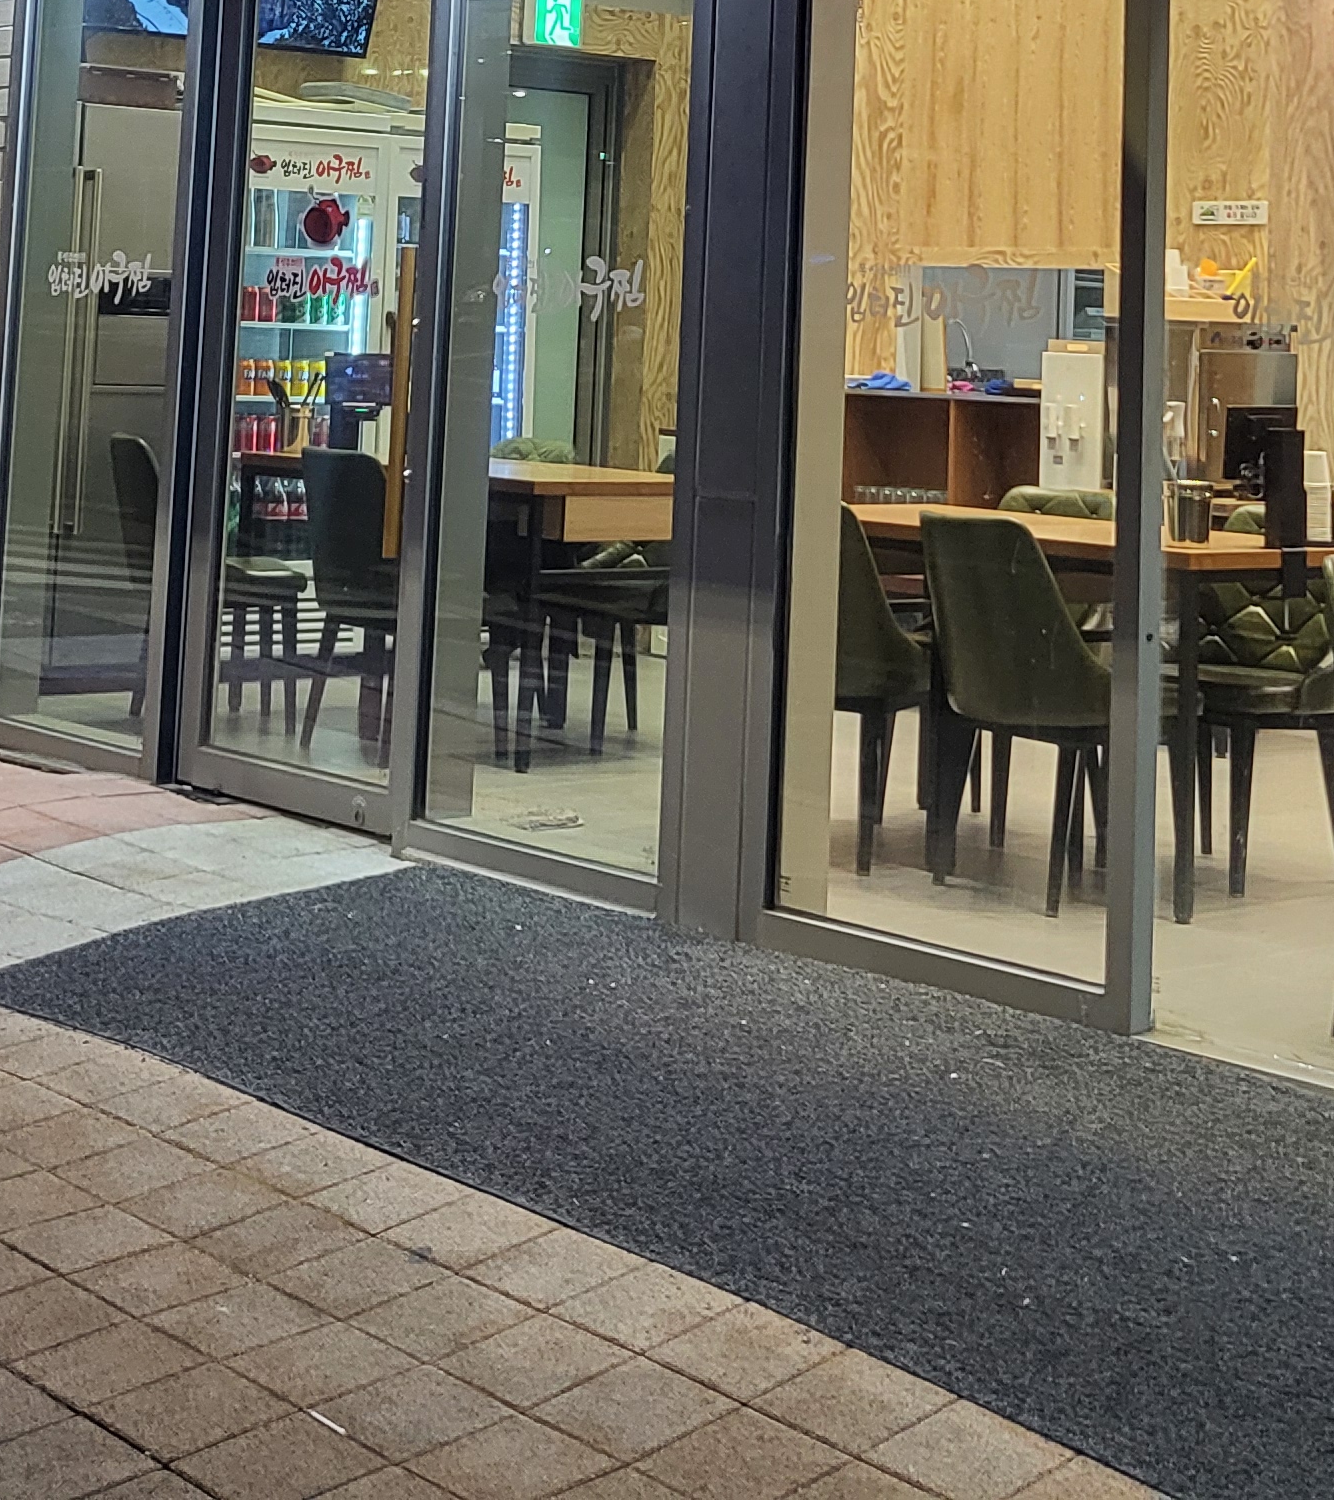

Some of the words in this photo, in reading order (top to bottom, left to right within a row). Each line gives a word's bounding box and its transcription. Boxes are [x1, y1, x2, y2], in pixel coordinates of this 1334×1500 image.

[280, 158, 314, 180] 입터진
[315, 153, 363, 185] 아구찜
[48, 264, 90, 299] 입터진
[90, 250, 153, 305] 아구찜
[266, 269, 307, 300] 입터진
[307, 256, 370, 306] 아구찜
